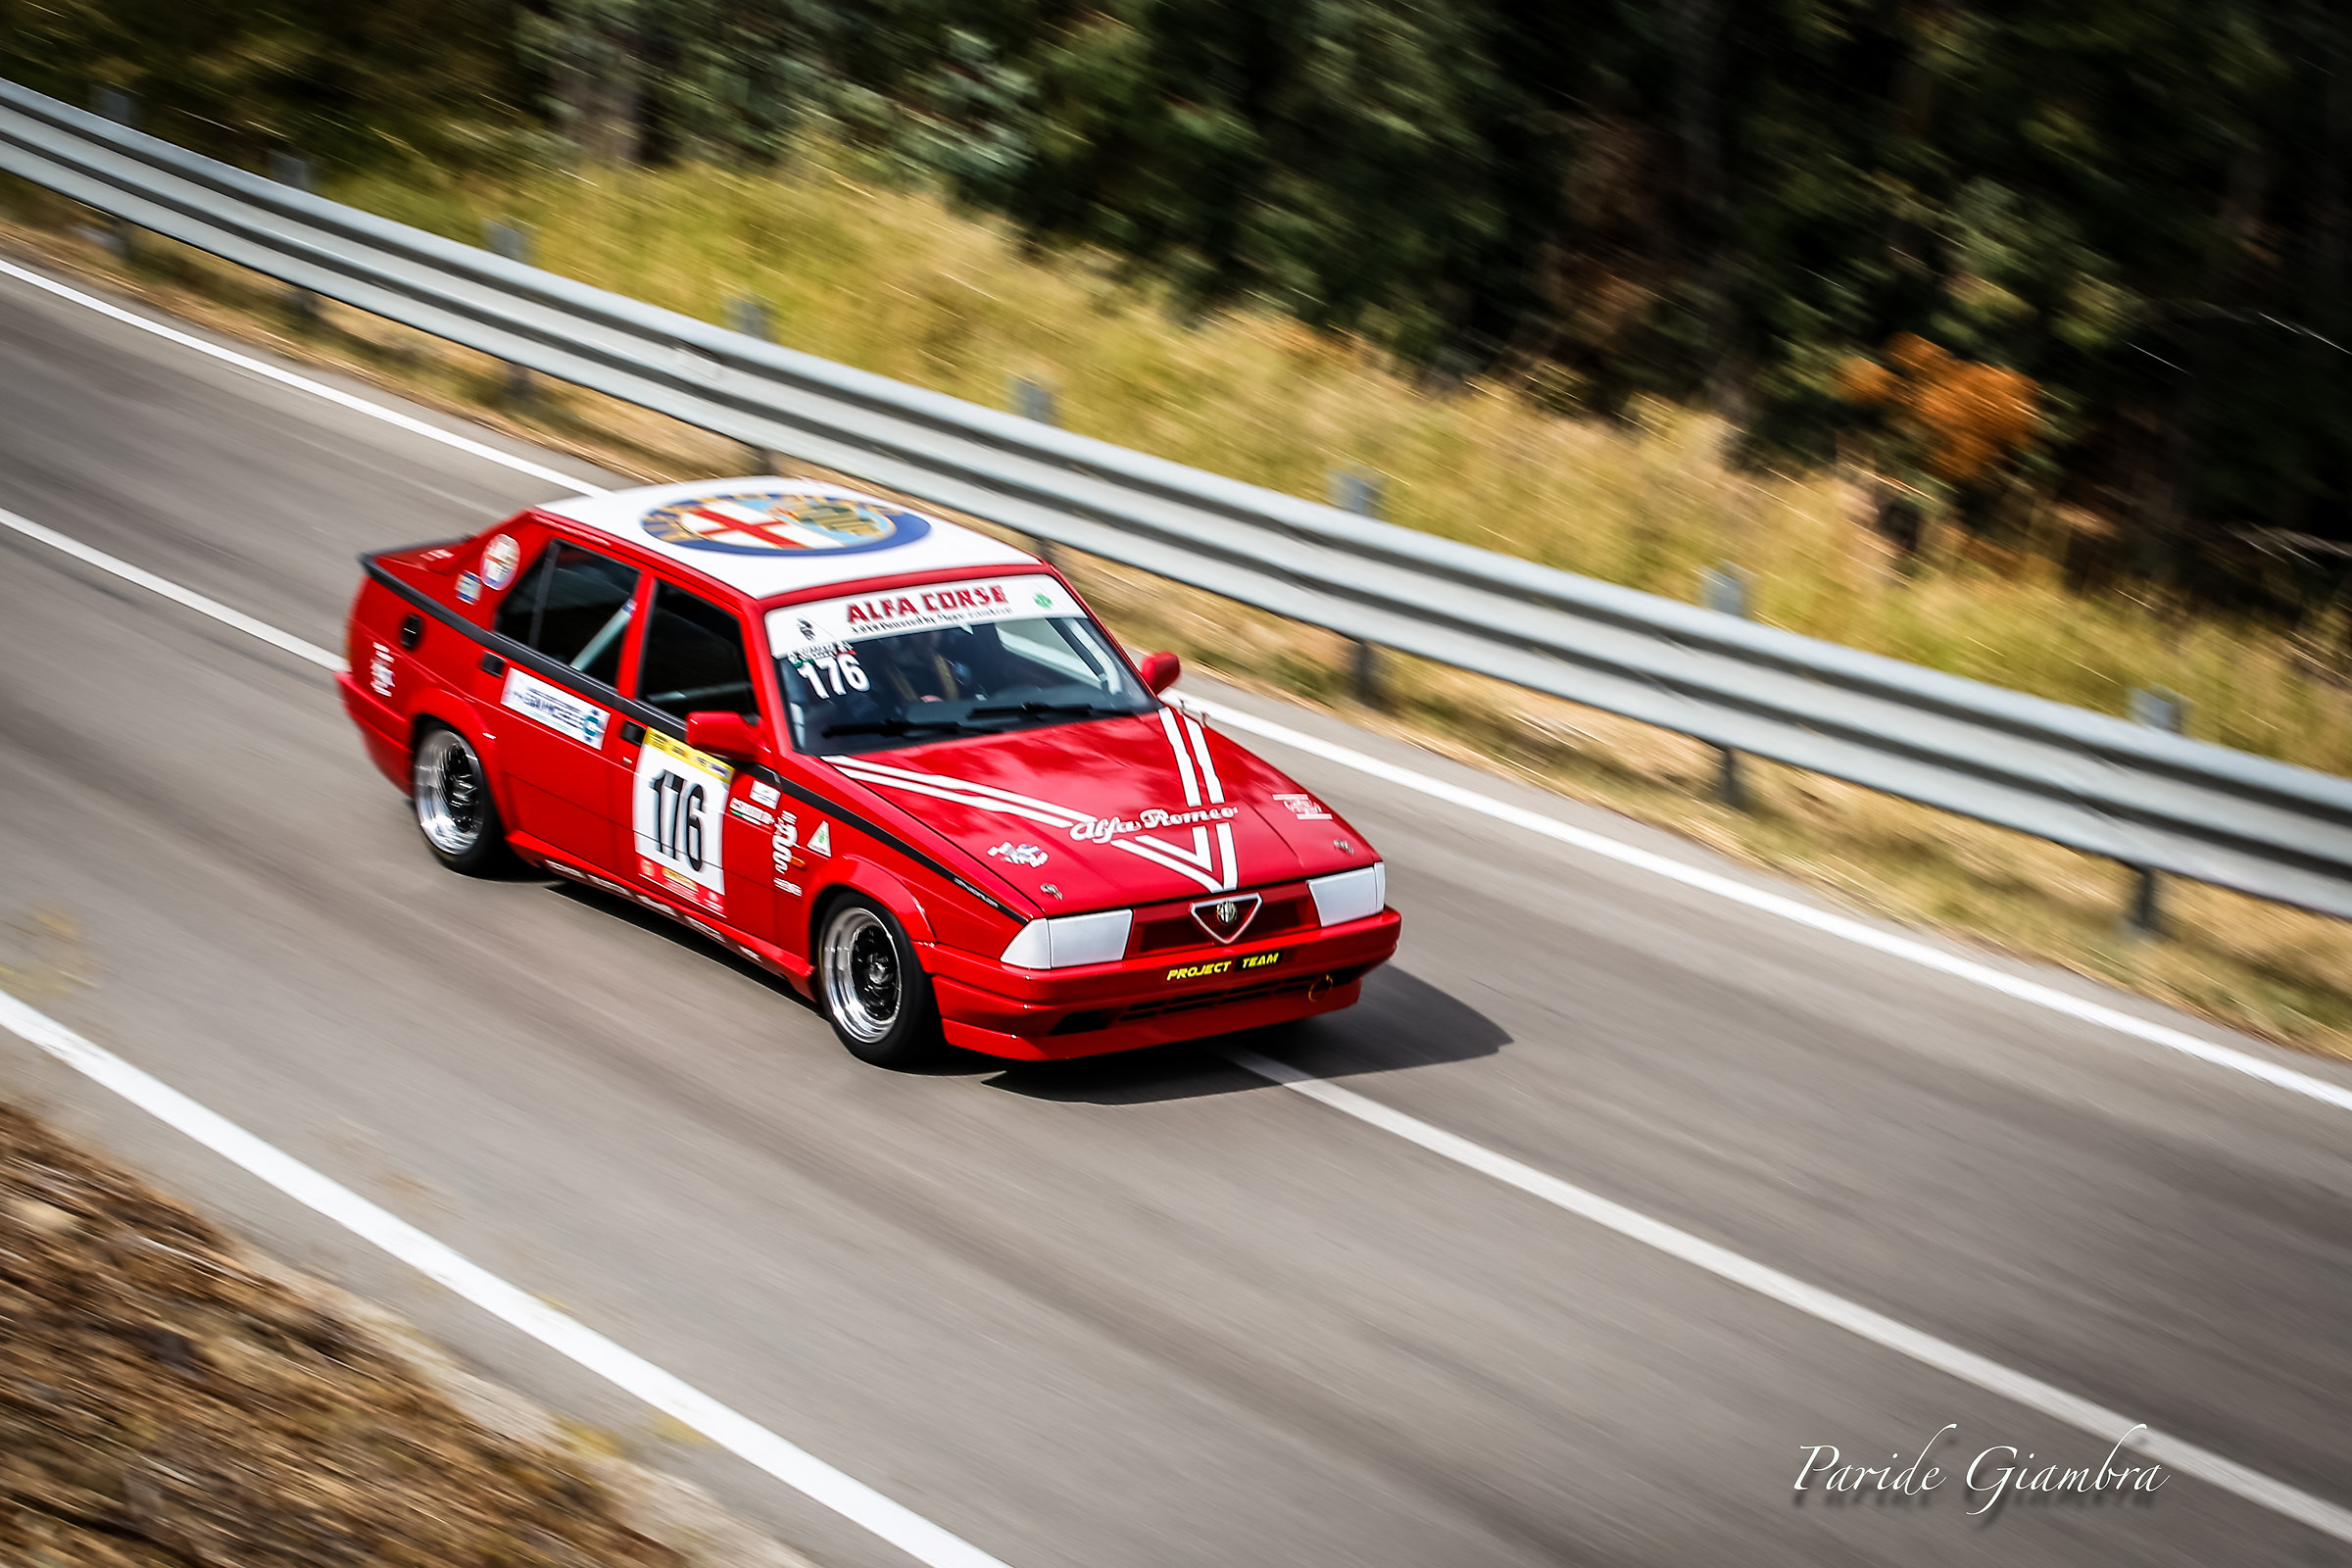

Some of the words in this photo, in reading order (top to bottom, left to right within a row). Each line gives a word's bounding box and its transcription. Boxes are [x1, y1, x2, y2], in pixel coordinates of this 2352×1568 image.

[848, 596, 919, 624] ALFA
[920, 585, 1009, 612] CORSE
[797, 654, 871, 699] 176
[650, 768, 705, 872] 176
[1069, 816, 1142, 844] Alfa
[1140, 807, 1238, 829] Romeo
[1166, 960, 1232, 981] PROJECT
[1242, 952, 1280, 969] TEAM
